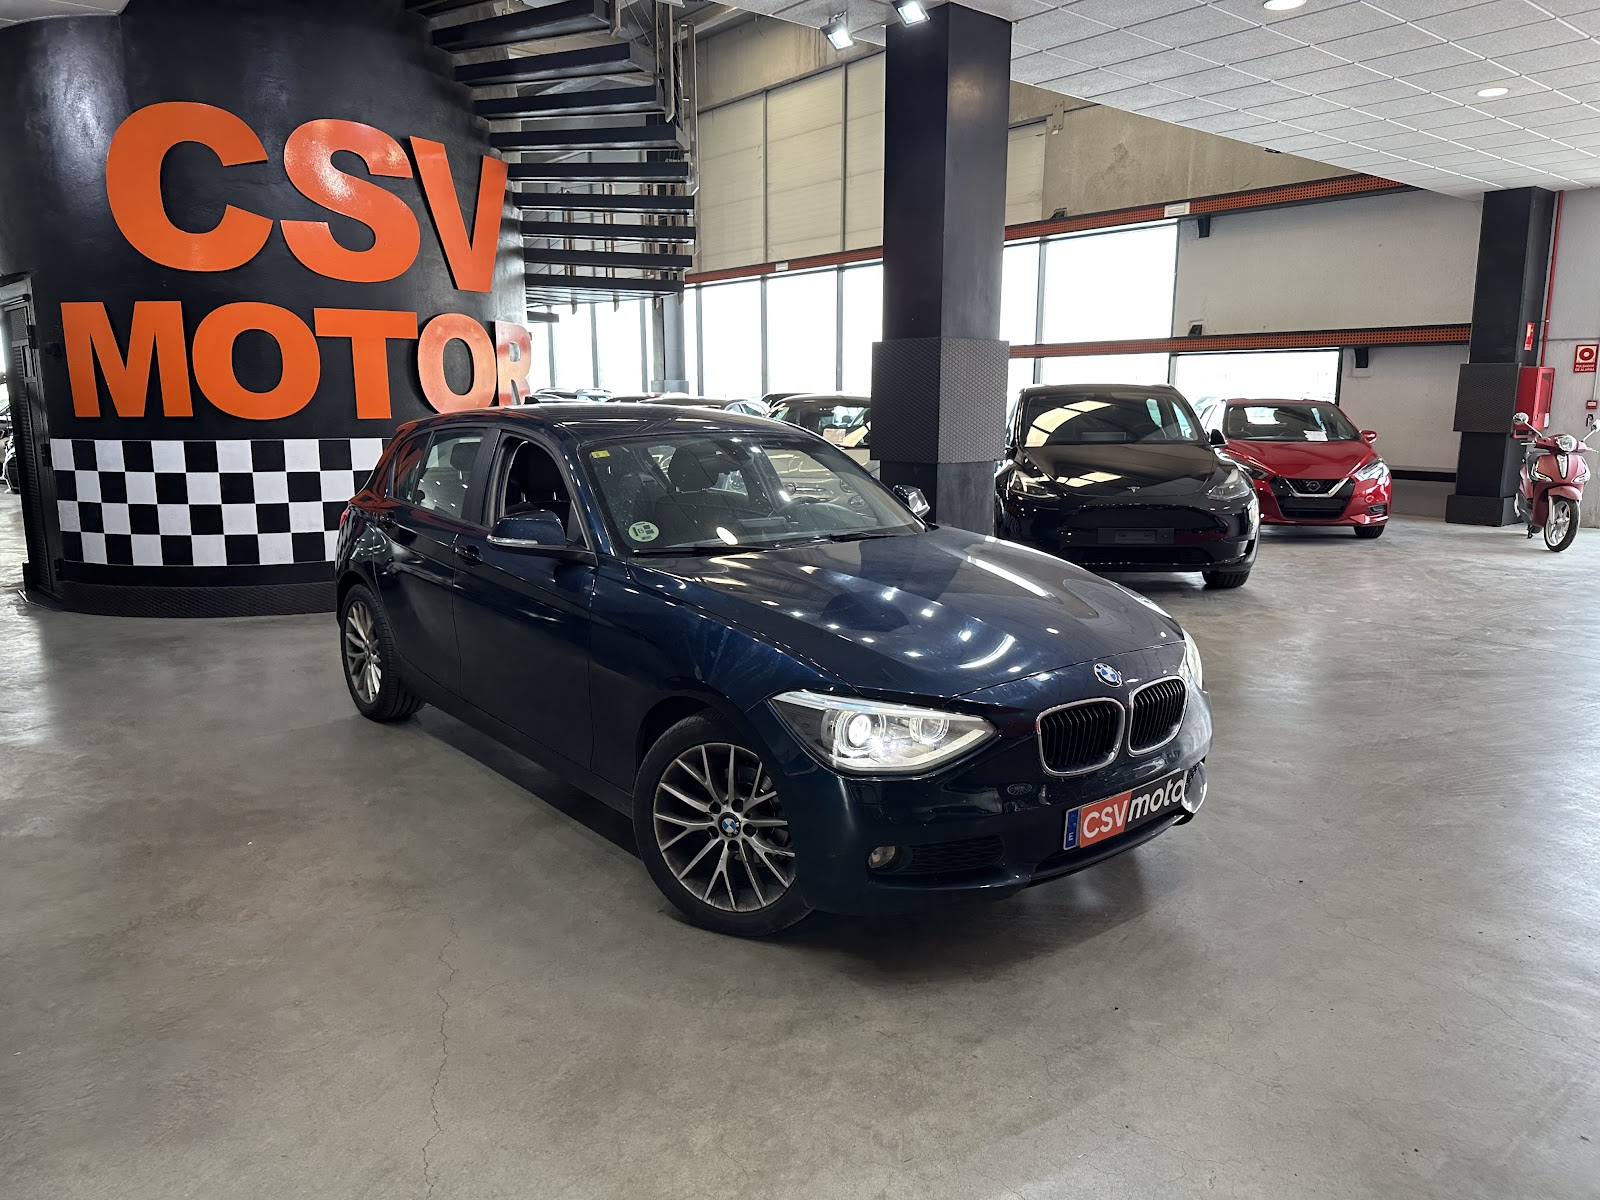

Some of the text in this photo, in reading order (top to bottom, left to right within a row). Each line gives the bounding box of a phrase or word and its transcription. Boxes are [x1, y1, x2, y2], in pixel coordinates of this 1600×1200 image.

[106, 101, 508, 293] CSV
[60, 301, 533, 420] MOTOR
[1068, 832, 1074, 841] E
[1083, 779, 1185, 838] CSVmoto
